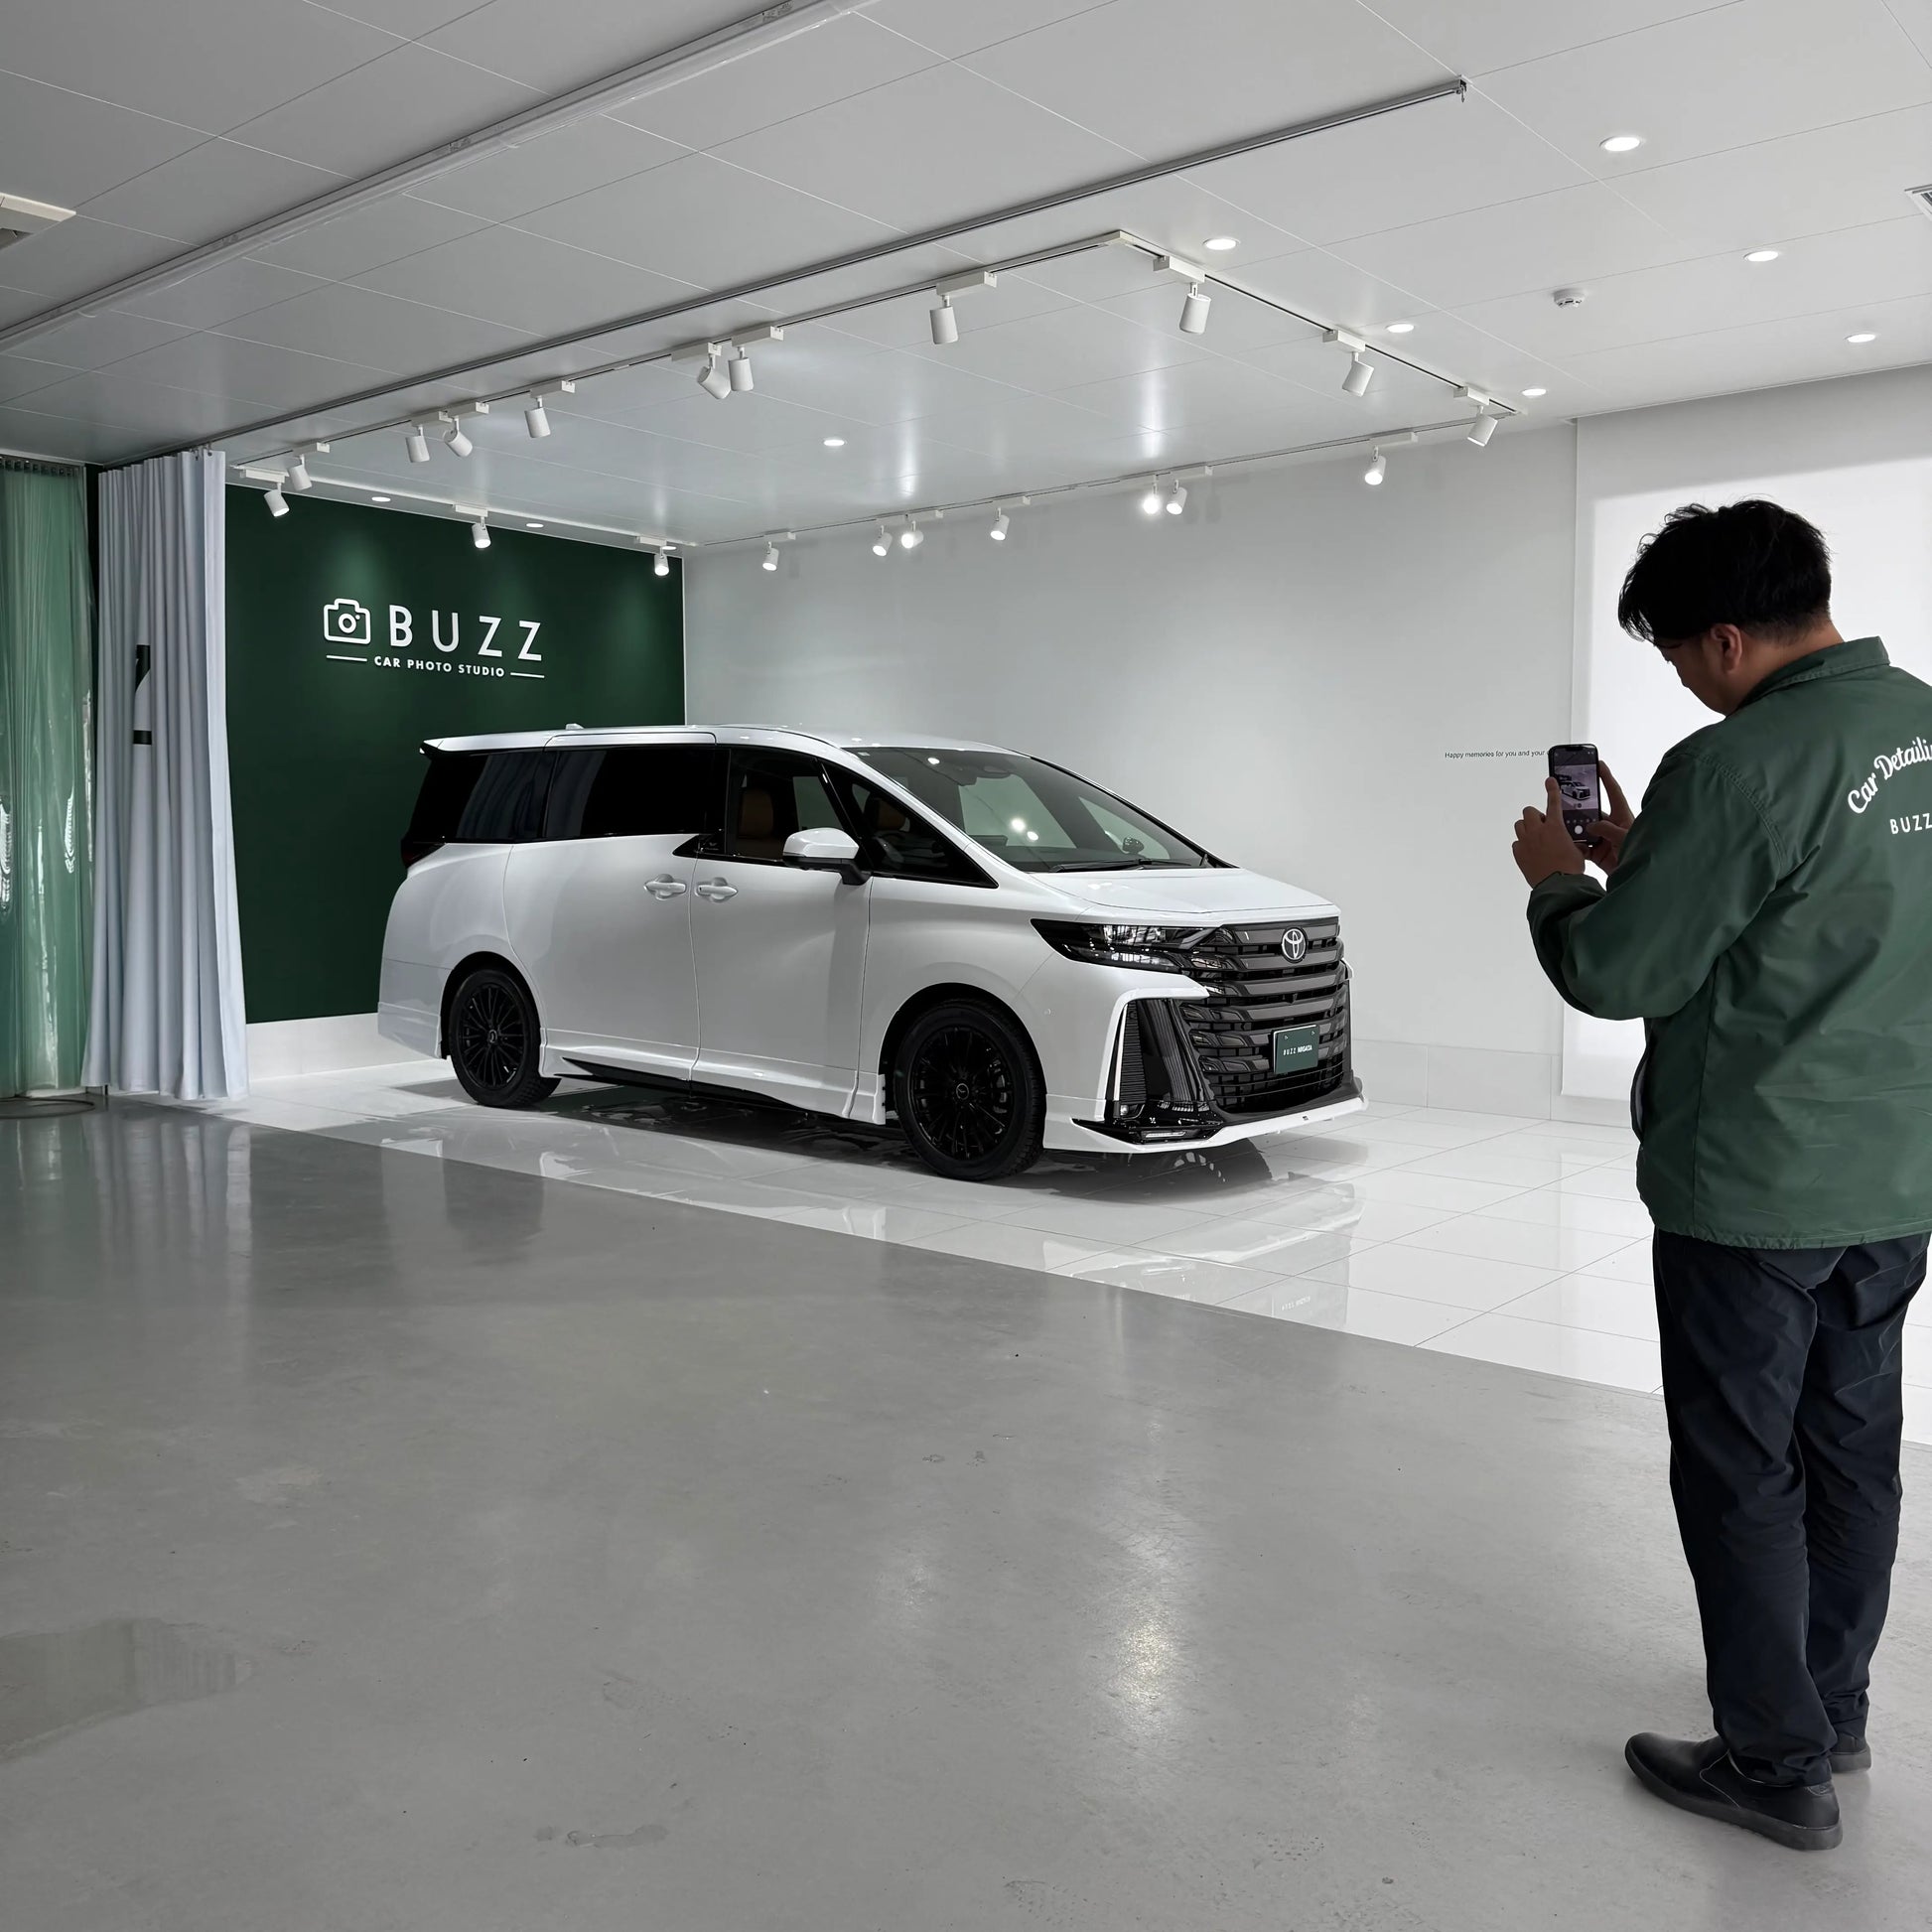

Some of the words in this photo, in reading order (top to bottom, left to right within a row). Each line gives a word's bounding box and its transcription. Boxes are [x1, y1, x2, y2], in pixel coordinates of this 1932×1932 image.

[389, 605, 542, 661] BUZZ
[374, 655, 401, 668] CAR
[407, 658, 452, 673] PHOTO
[458, 663, 504, 677] STUDIO
[1848, 772, 1878, 814] Car
[1873, 736, 1932, 780] Detaili
[1889, 813, 1932, 834] BUZZ
